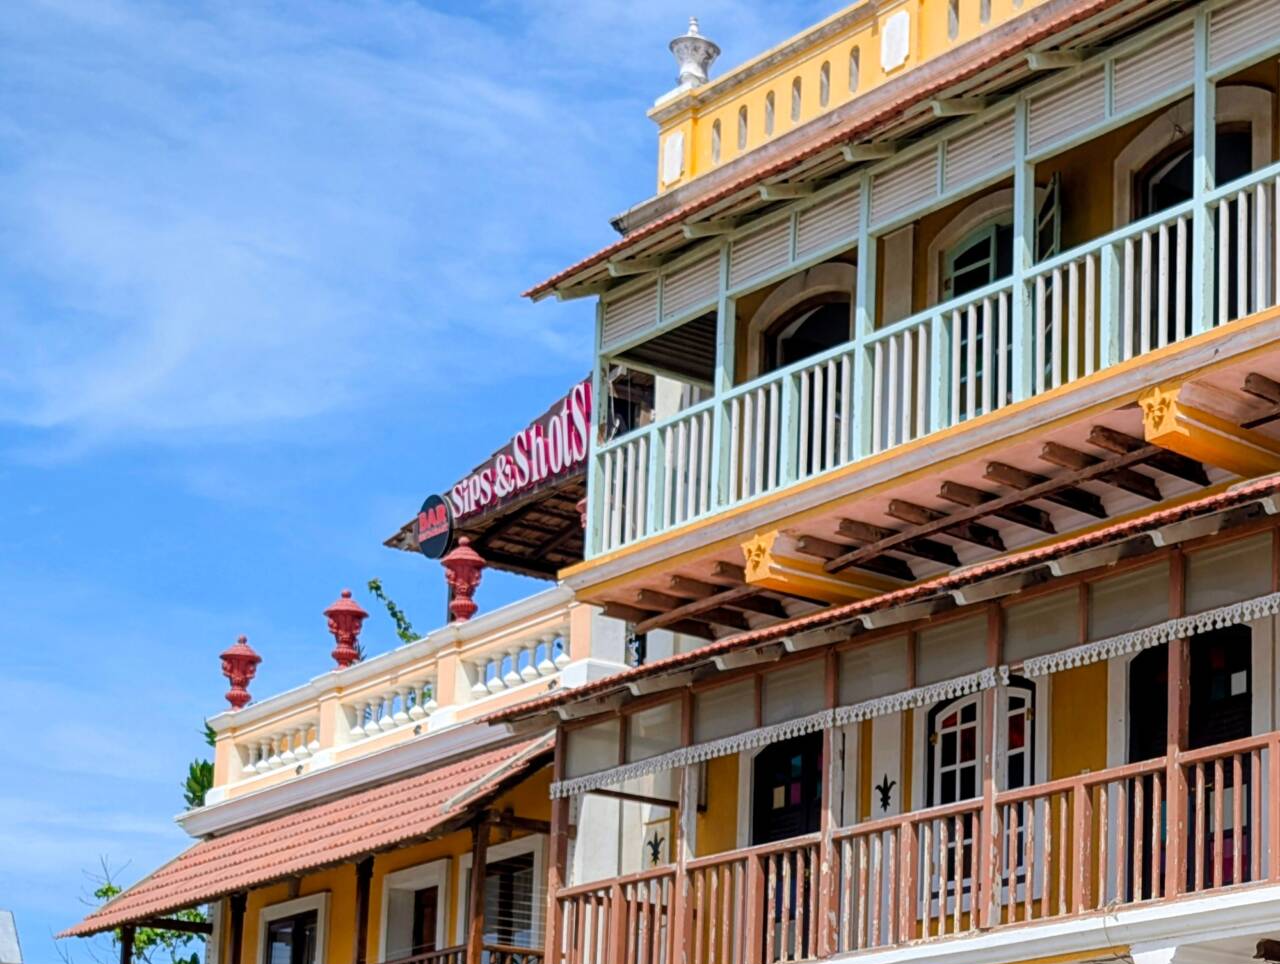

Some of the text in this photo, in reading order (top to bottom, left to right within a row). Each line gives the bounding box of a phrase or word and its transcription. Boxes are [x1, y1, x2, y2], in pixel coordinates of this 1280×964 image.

[451, 468, 495, 519] Sips
[493, 454, 516, 498] &
[418, 503, 447, 532] BAR
